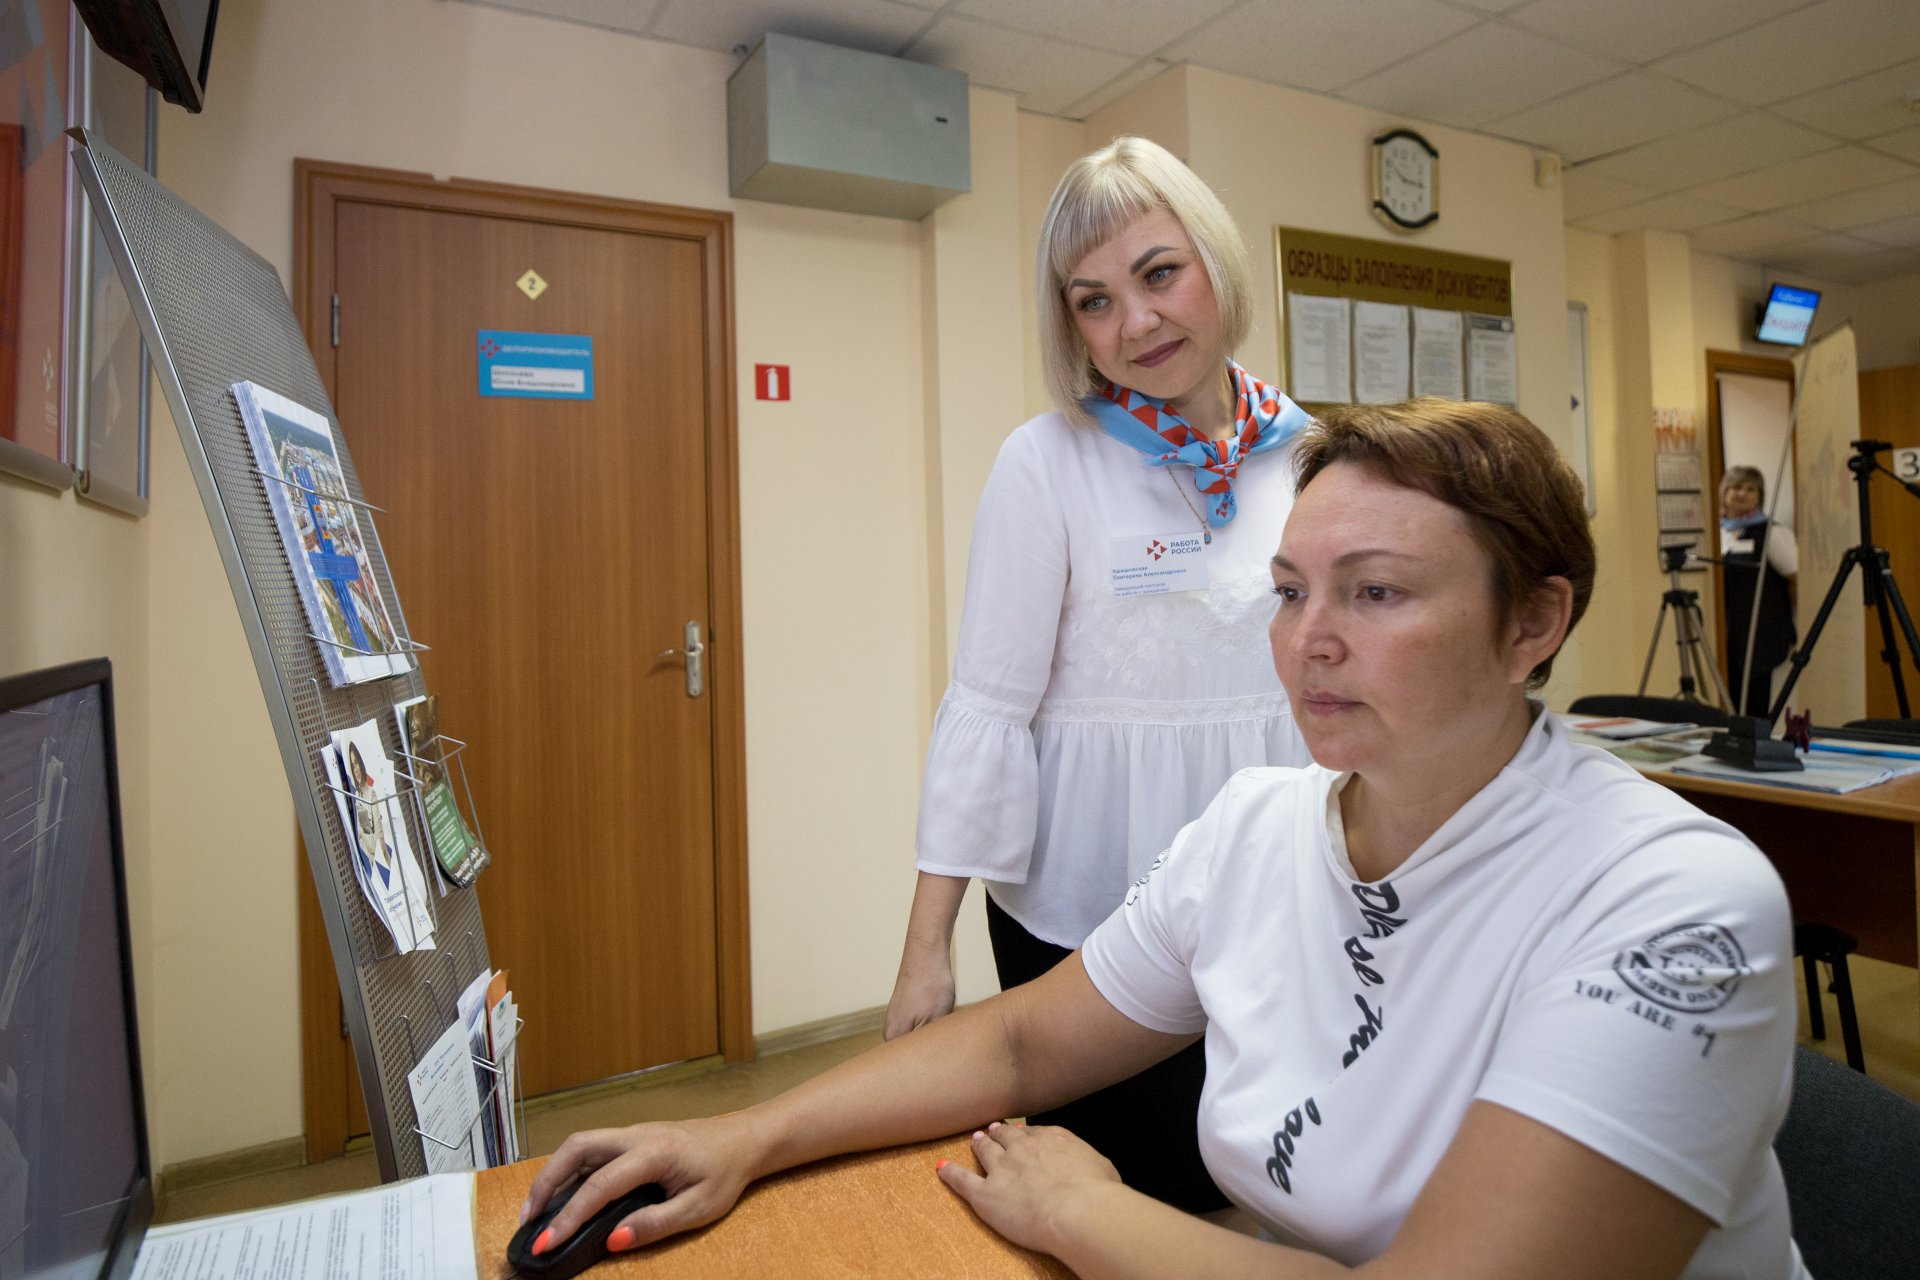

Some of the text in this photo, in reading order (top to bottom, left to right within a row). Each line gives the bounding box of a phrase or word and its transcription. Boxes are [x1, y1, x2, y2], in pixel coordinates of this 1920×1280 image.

[527, 276, 537, 290] 2
[1287, 249, 1509, 302] ОБРАЗЦЫ ЗАПОЛНЕНИЯ ДОКУМЕНТОВ
[1900, 450, 1920, 478] 3
[1170, 539, 1200, 548] РАБОТА
[1171, 546, 1202, 555] РОССИИ
[1574, 978, 1622, 1005] YOU
[1626, 1000, 1678, 1031] ARE
